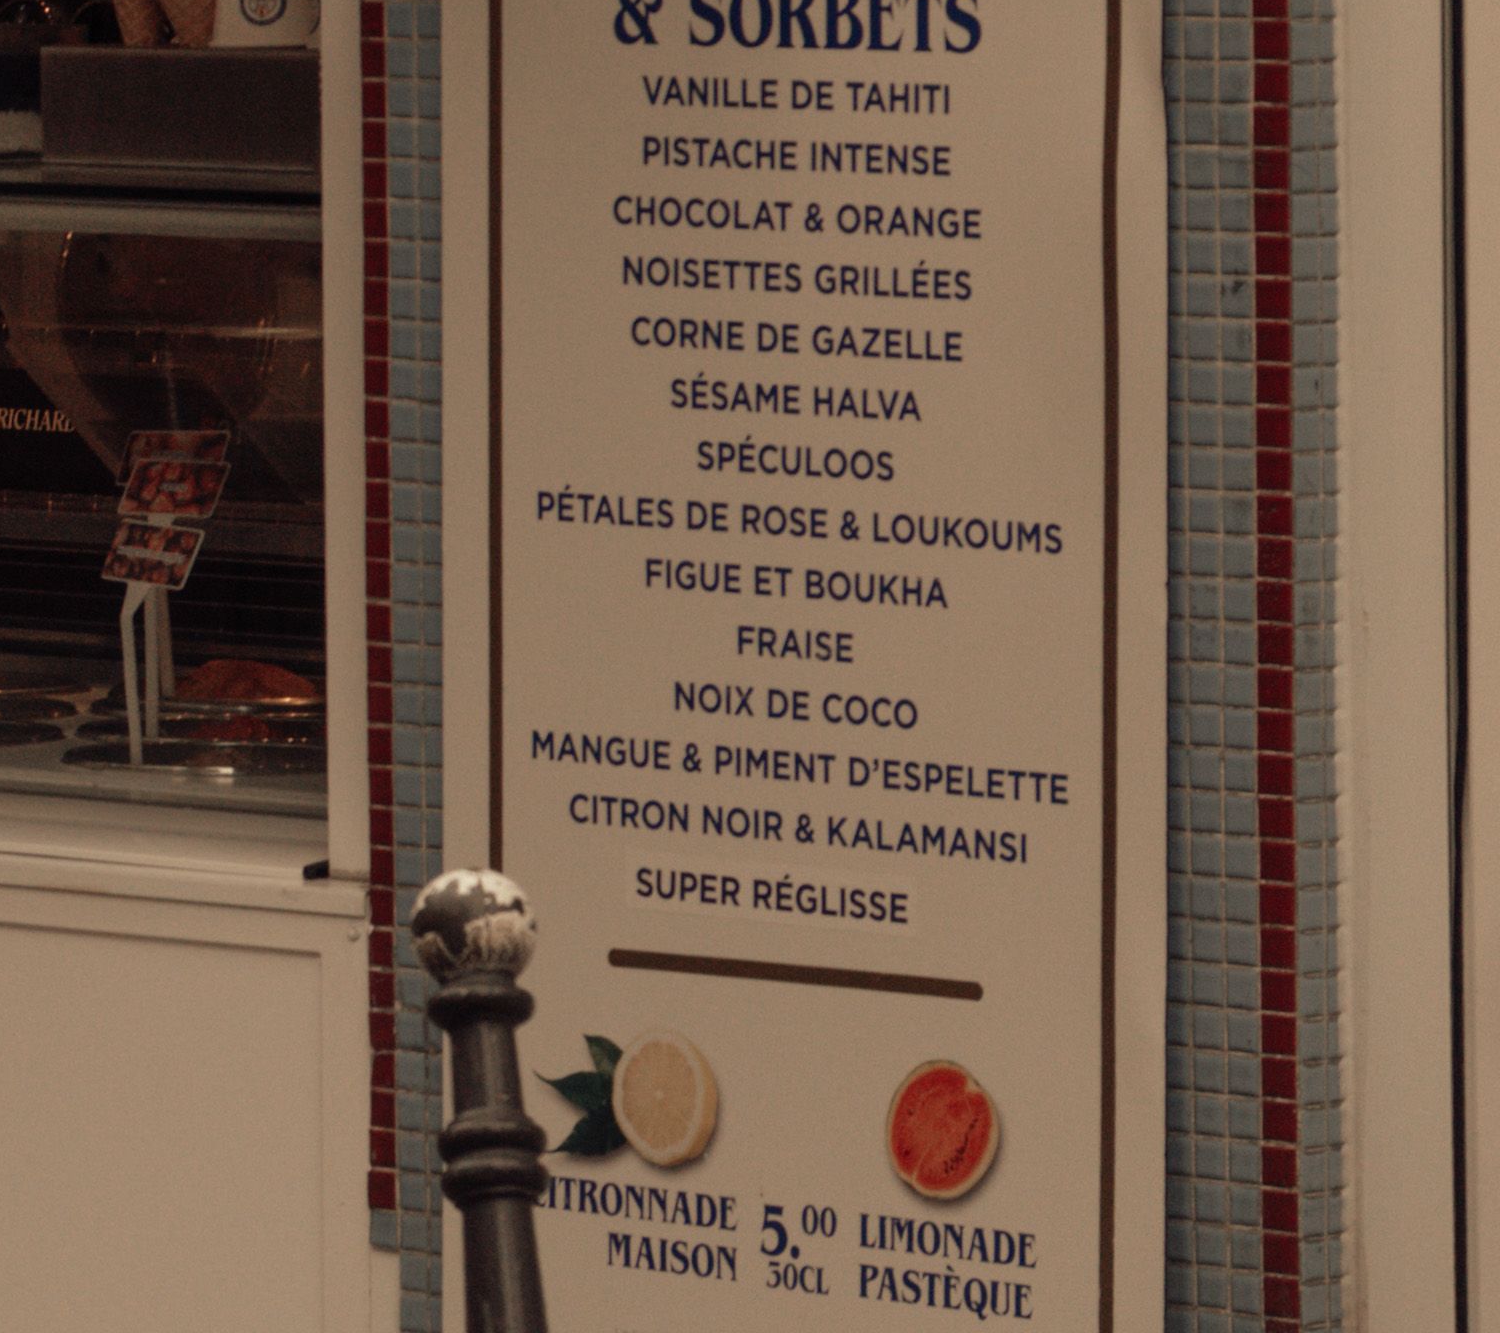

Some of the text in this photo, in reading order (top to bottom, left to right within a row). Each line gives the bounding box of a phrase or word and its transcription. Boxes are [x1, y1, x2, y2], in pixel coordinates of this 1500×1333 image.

[642, 75, 950, 115] VANILLE DE TAHITI
[642, 135, 951, 177] PISTACHE INTENSE
[612, 194, 982, 240] CHOCOLAT & ORANGE
[622, 255, 972, 302] NOISETTES GRILLÉES
[630, 315, 963, 363] CORNE DE GAZELLE
[670, 371, 922, 422] SÉSAME HALVA
[697, 435, 895, 482] SPÉCULOOS
[537, 484, 1063, 555] PÉTALES DE ROSE & LOUKOUMS
[645, 558, 948, 609] FIGUE ET BOUKHA
[737, 625, 853, 664] FRAISE
[674, 681, 919, 730] NOIX DE COCO
[531, 730, 1069, 806] MANGUE & PIMENT D'ESPELETTE
[568, 793, 1027, 864] CITRON NOIR & KALAMANSI
[636, 867, 908, 925] SUPER RÉGLISSE
[760, 1203, 839, 1260] 5.00
[859, 1213, 1038, 1270] LIMONADE
[608, 1232, 738, 1282] MAISON
[858, 1263, 1034, 1322] PASTÈQUE
